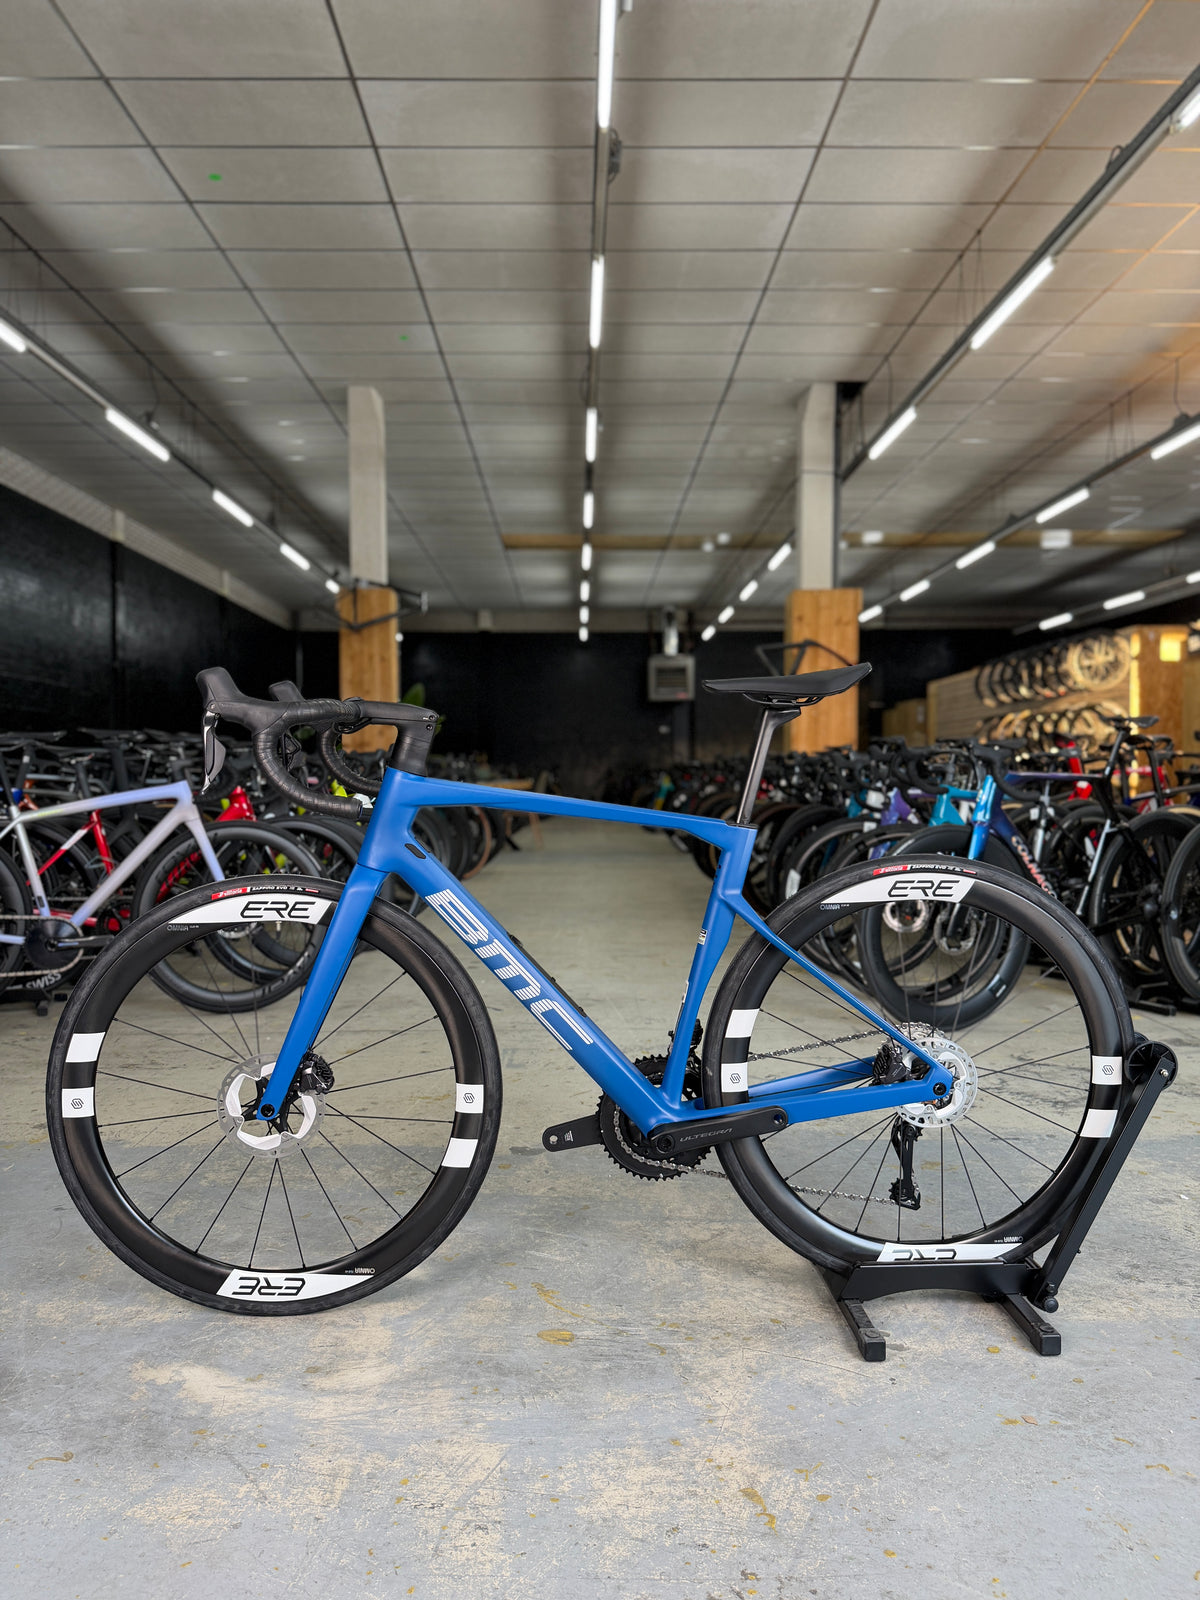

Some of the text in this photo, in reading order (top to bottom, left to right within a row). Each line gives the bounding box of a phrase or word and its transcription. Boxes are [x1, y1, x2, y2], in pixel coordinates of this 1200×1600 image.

[888, 880, 960, 897] ERE
[240, 901, 316, 918] ERE
[26, 972, 61, 988] SWISS
[680, 1128, 733, 1142] ULTEGRA
[232, 1277, 306, 1296] ERE
